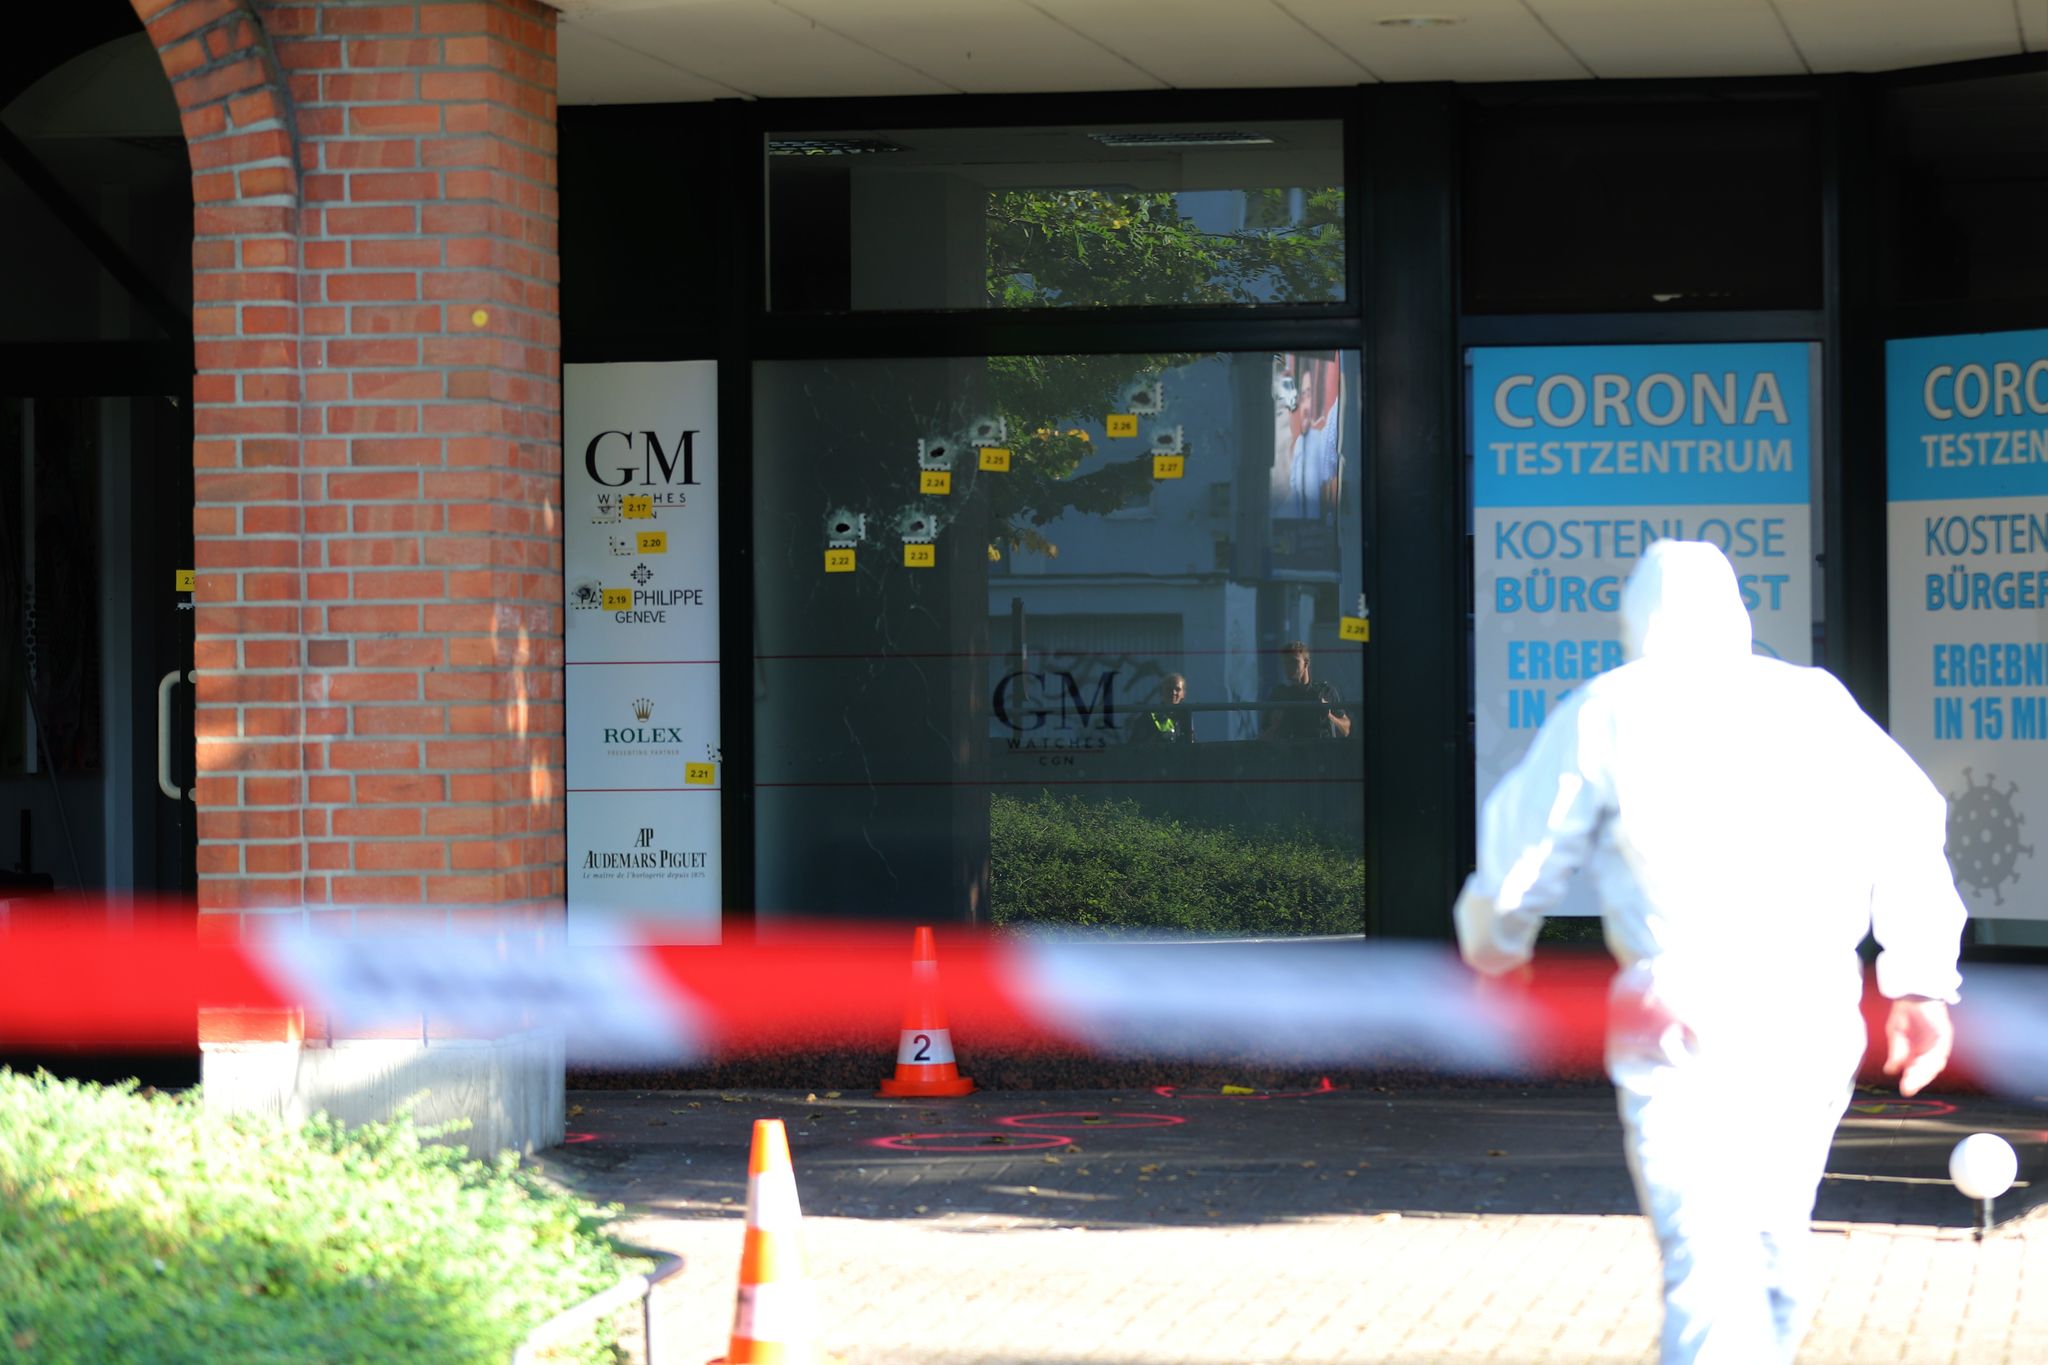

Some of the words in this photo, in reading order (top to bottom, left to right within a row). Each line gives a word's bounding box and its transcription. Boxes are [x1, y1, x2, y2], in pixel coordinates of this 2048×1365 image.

[1493, 372, 1790, 428] CORONA
[585, 430, 701, 487] GM
[1489, 439, 1793, 476] TESTZENTRUM
[1921, 430, 2048, 468] TESTZEN
[927, 479, 944, 487] 2.24
[628, 504, 647, 512] 2.17
[643, 539, 661, 547] 2.20
[1925, 513, 2048, 557] KOSTEN
[608, 596, 626, 604] 2.19
[633, 589, 703, 606] PHILIPPE
[1494, 568, 1790, 614] BÜRGST
[615, 610, 667, 624] GENEVE
[992, 670, 1123, 731] GM
[1508, 688, 1546, 729] IN
[1934, 697, 1963, 740] IN
[1969, 697, 2003, 740] 15
[603, 727, 683, 743] ROLEX
[1007, 737, 1106, 749] WATCHES
[1039, 756, 1075, 767] CGN
[690, 770, 708, 778] 2.21
[634, 827, 654, 847] AP
[583, 850, 657, 869] AUDEMARS
[659, 849, 707, 869] PIGUET
[913, 1034, 931, 1061] 2
